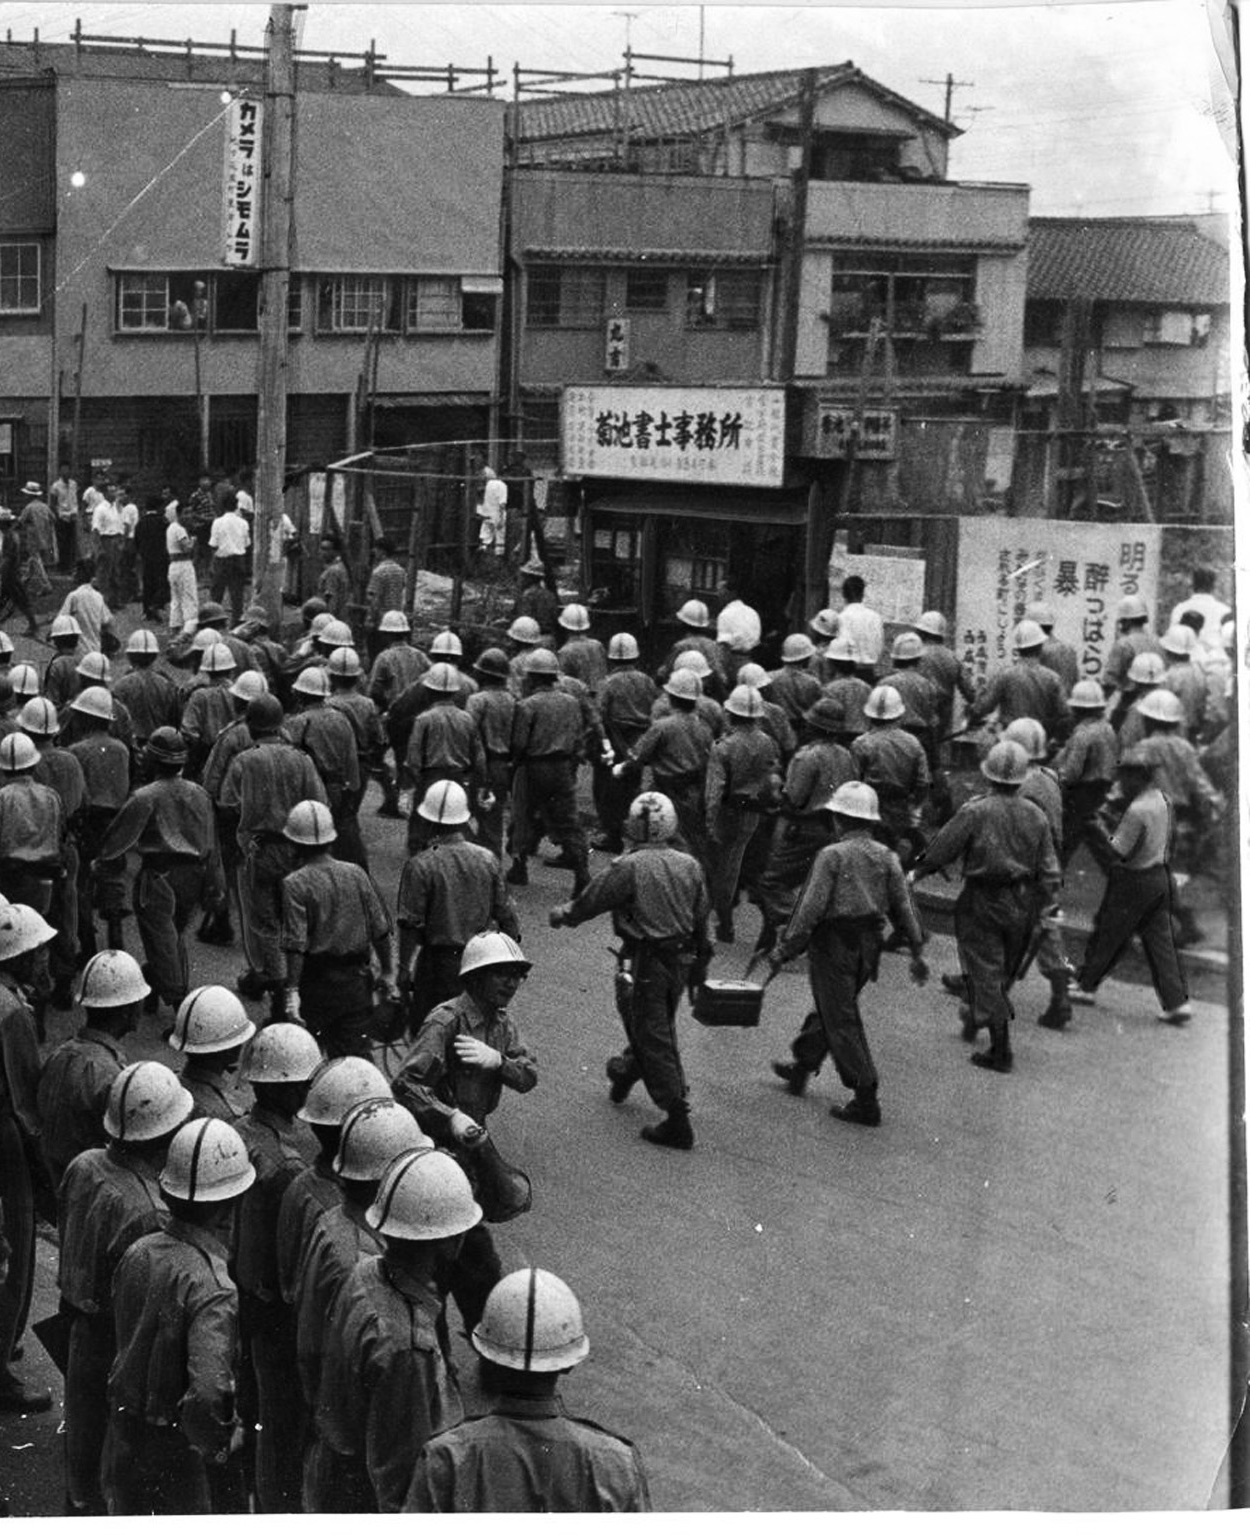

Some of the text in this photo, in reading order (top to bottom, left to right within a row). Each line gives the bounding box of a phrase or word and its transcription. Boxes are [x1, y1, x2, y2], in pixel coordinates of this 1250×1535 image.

[235, 102, 257, 260] カメラはシモムラ
[595, 409, 744, 451] 菊池書士事務所
[1081, 562, 1111, 684] 酔っぱら
